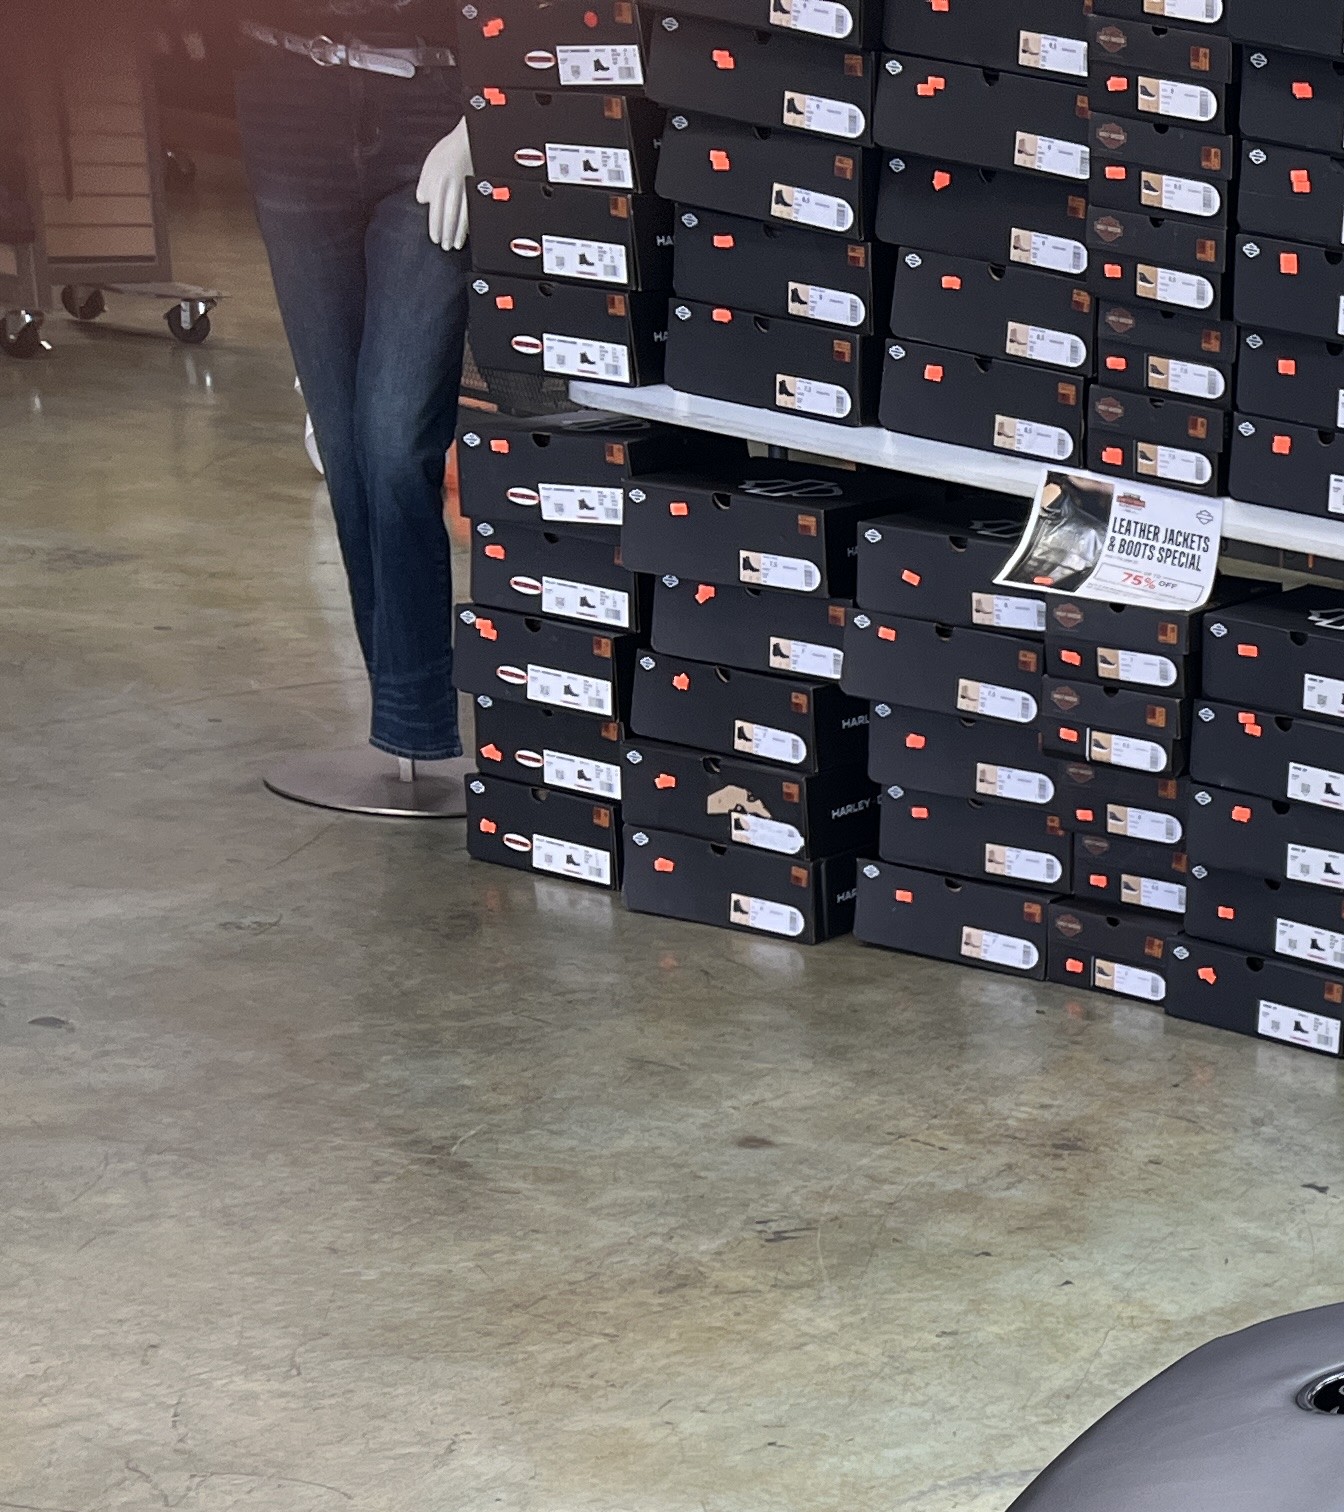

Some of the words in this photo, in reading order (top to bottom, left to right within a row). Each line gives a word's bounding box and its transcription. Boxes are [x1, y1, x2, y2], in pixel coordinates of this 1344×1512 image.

[1111, 516, 1160, 542] LEATHER
[1162, 528, 1211, 553] JACKETS
[1107, 535, 1116, 551] &
[1117, 538, 1155, 561] BOOTS
[1156, 546, 1202, 572] SPECIAL
[1121, 571, 1156, 590] 75%
[1158, 580, 1178, 589] OFF
